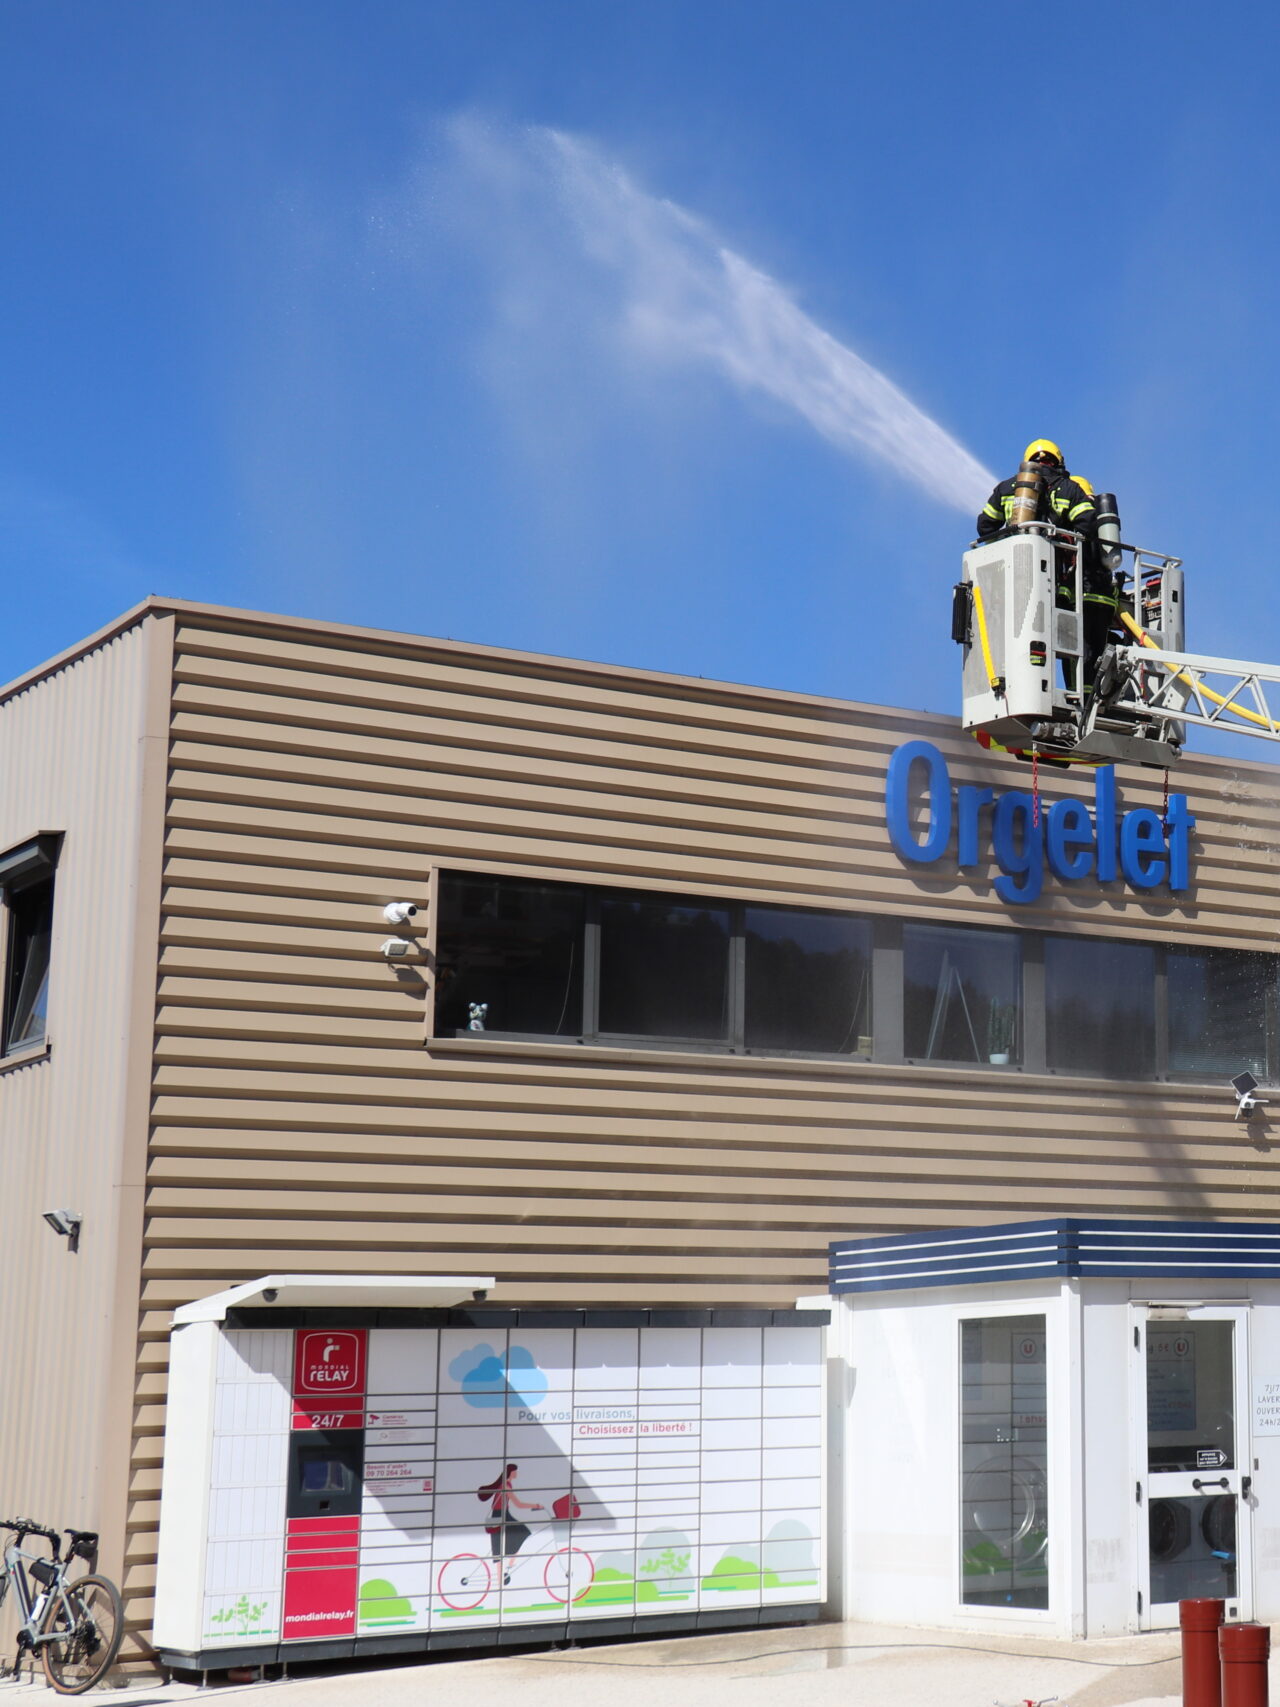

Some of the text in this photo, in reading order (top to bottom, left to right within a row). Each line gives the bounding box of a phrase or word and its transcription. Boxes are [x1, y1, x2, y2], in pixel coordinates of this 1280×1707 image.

[886, 741, 1195, 903] Orgelet
[312, 1414, 344, 1428] 24/7
[518, 1408, 636, 1421] Pour vos livraisons,
[579, 1424, 634, 1434] Choisissez
[640, 1424, 649, 1433] la
[652, 1422, 686, 1432] liberté
[286, 1610, 354, 1622] mondialrelay.fr
